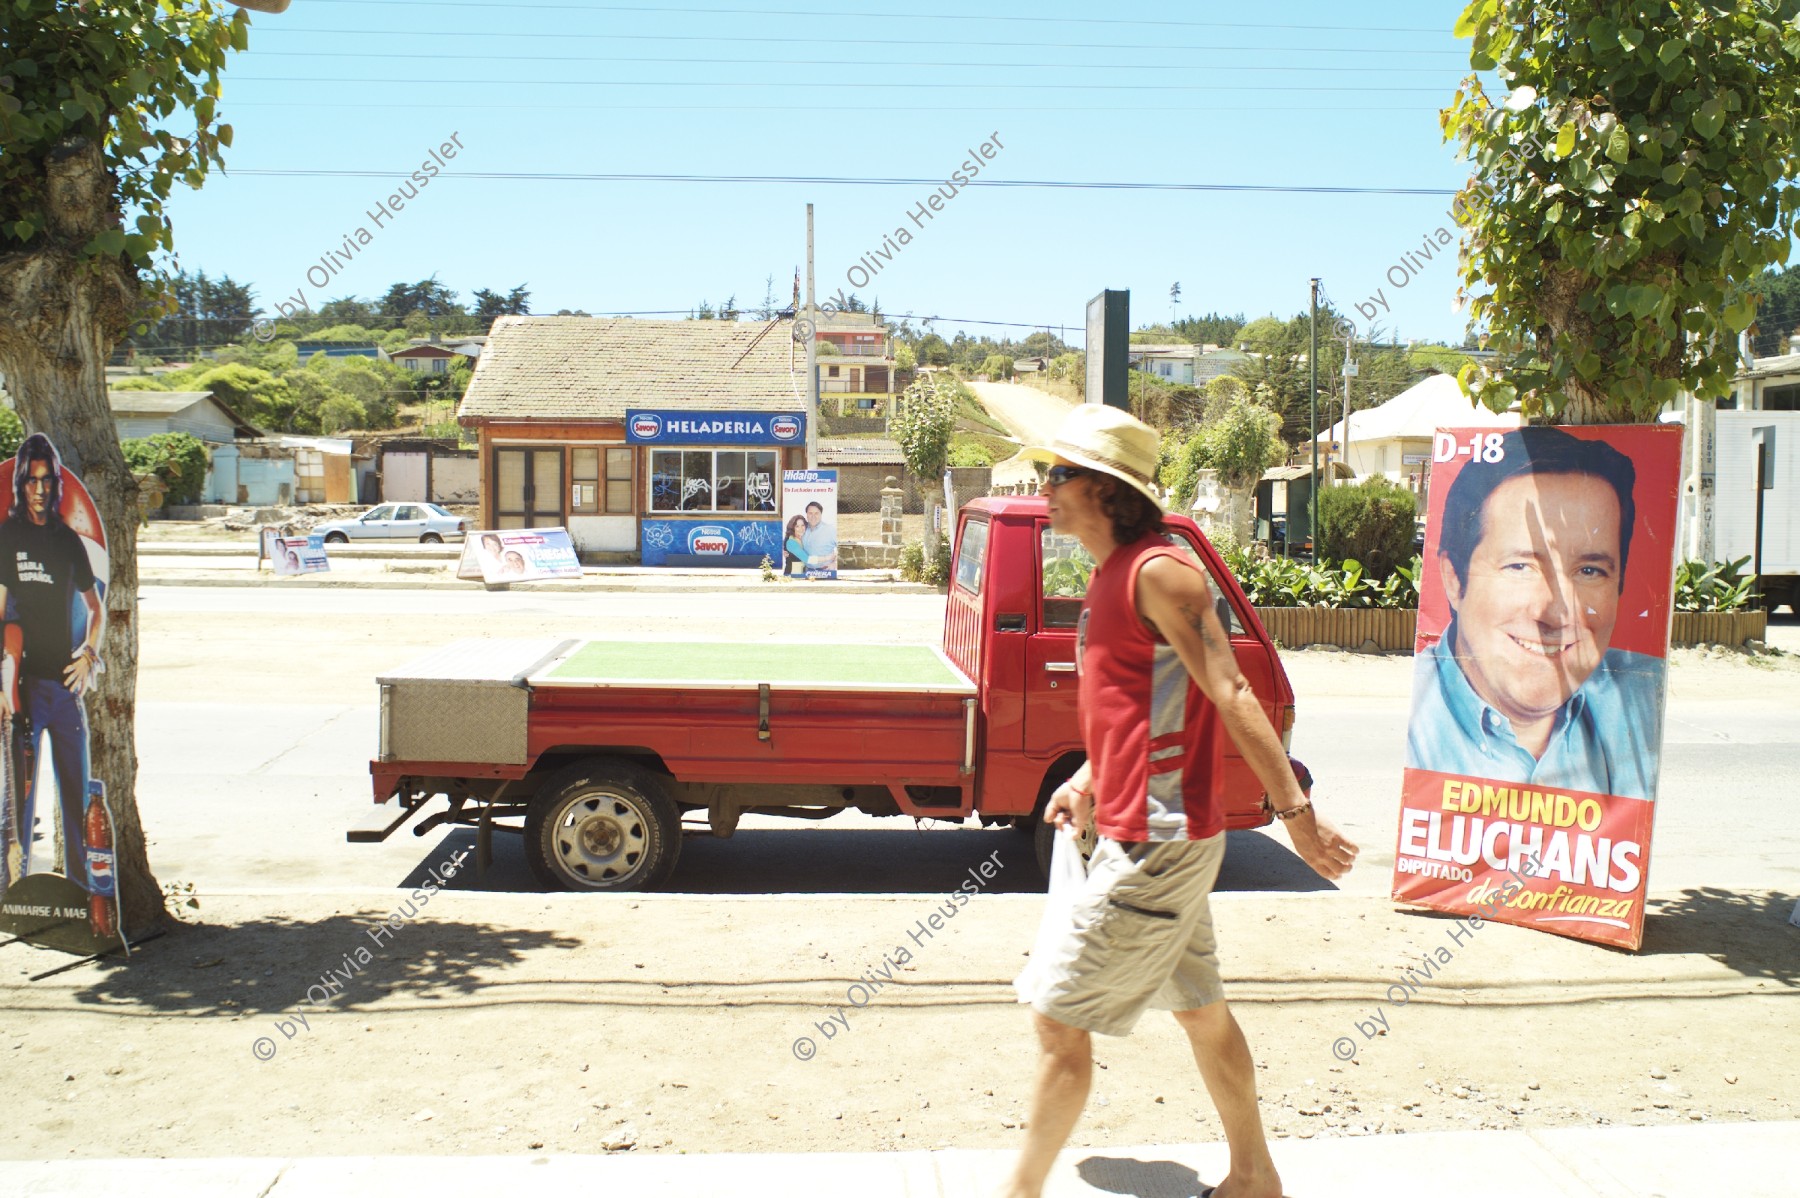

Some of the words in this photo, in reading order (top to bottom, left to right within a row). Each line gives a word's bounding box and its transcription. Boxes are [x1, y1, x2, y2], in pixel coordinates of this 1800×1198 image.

[635, 422, 657, 433] Savory
[667, 420, 764, 434] HELADERIA
[774, 424, 796, 434] Savory
[1433, 432, 1504, 463] D-18
[784, 470, 818, 482] Hidalgo
[695, 539, 727, 553] Savory
[16, 552, 28, 560] SE
[527, 547, 575, 560] VENEGAS
[17, 561, 44, 571] HABLA
[1441, 780, 1602, 831] EDMUNDO
[1400, 808, 1640, 893] ELUCHANS
[1398, 857, 1473, 883] DIPUTADO
[1503, 880, 1633, 918] Confianza
[2, 903, 50, 917] ANIMARSE
[53, 906, 61, 918] A
[63, 908, 87, 919] MAS
